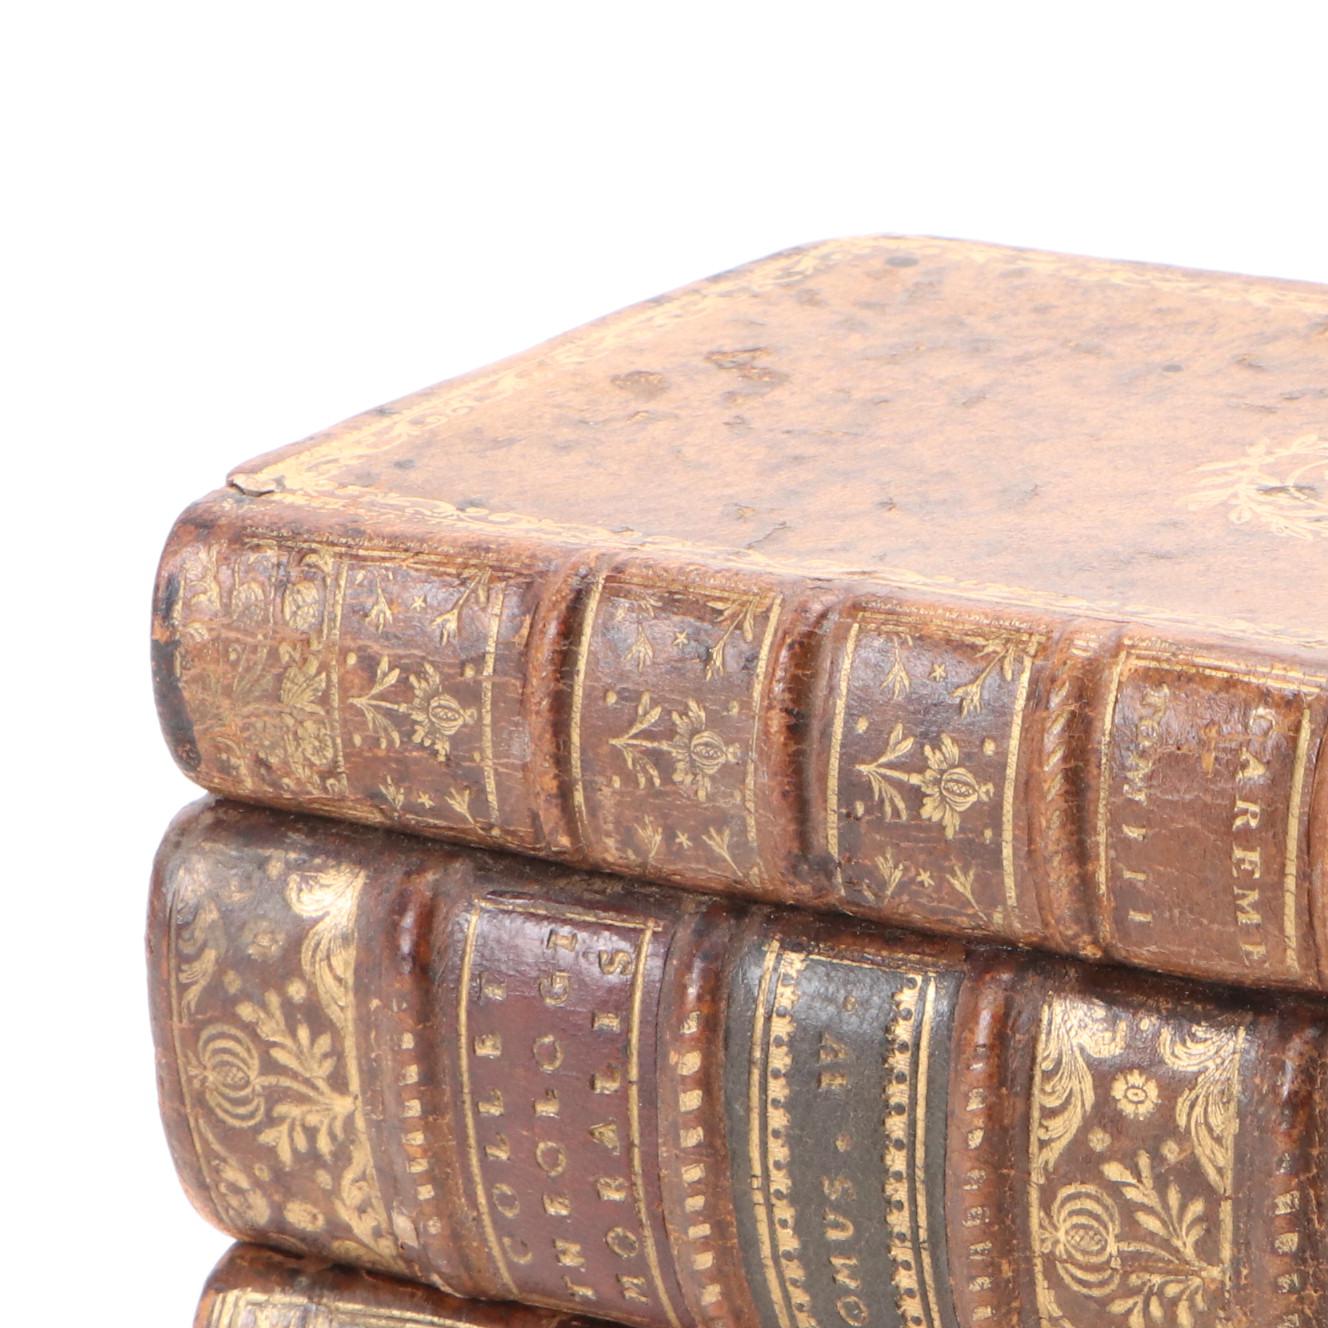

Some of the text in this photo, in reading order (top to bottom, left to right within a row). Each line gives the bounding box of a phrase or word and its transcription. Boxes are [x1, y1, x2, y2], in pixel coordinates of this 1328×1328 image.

[474, 972, 533, 1266] COLLET
[533, 929, 596, 1301] THEOLOGI
[590, 949, 650, 1302] MORALIS
